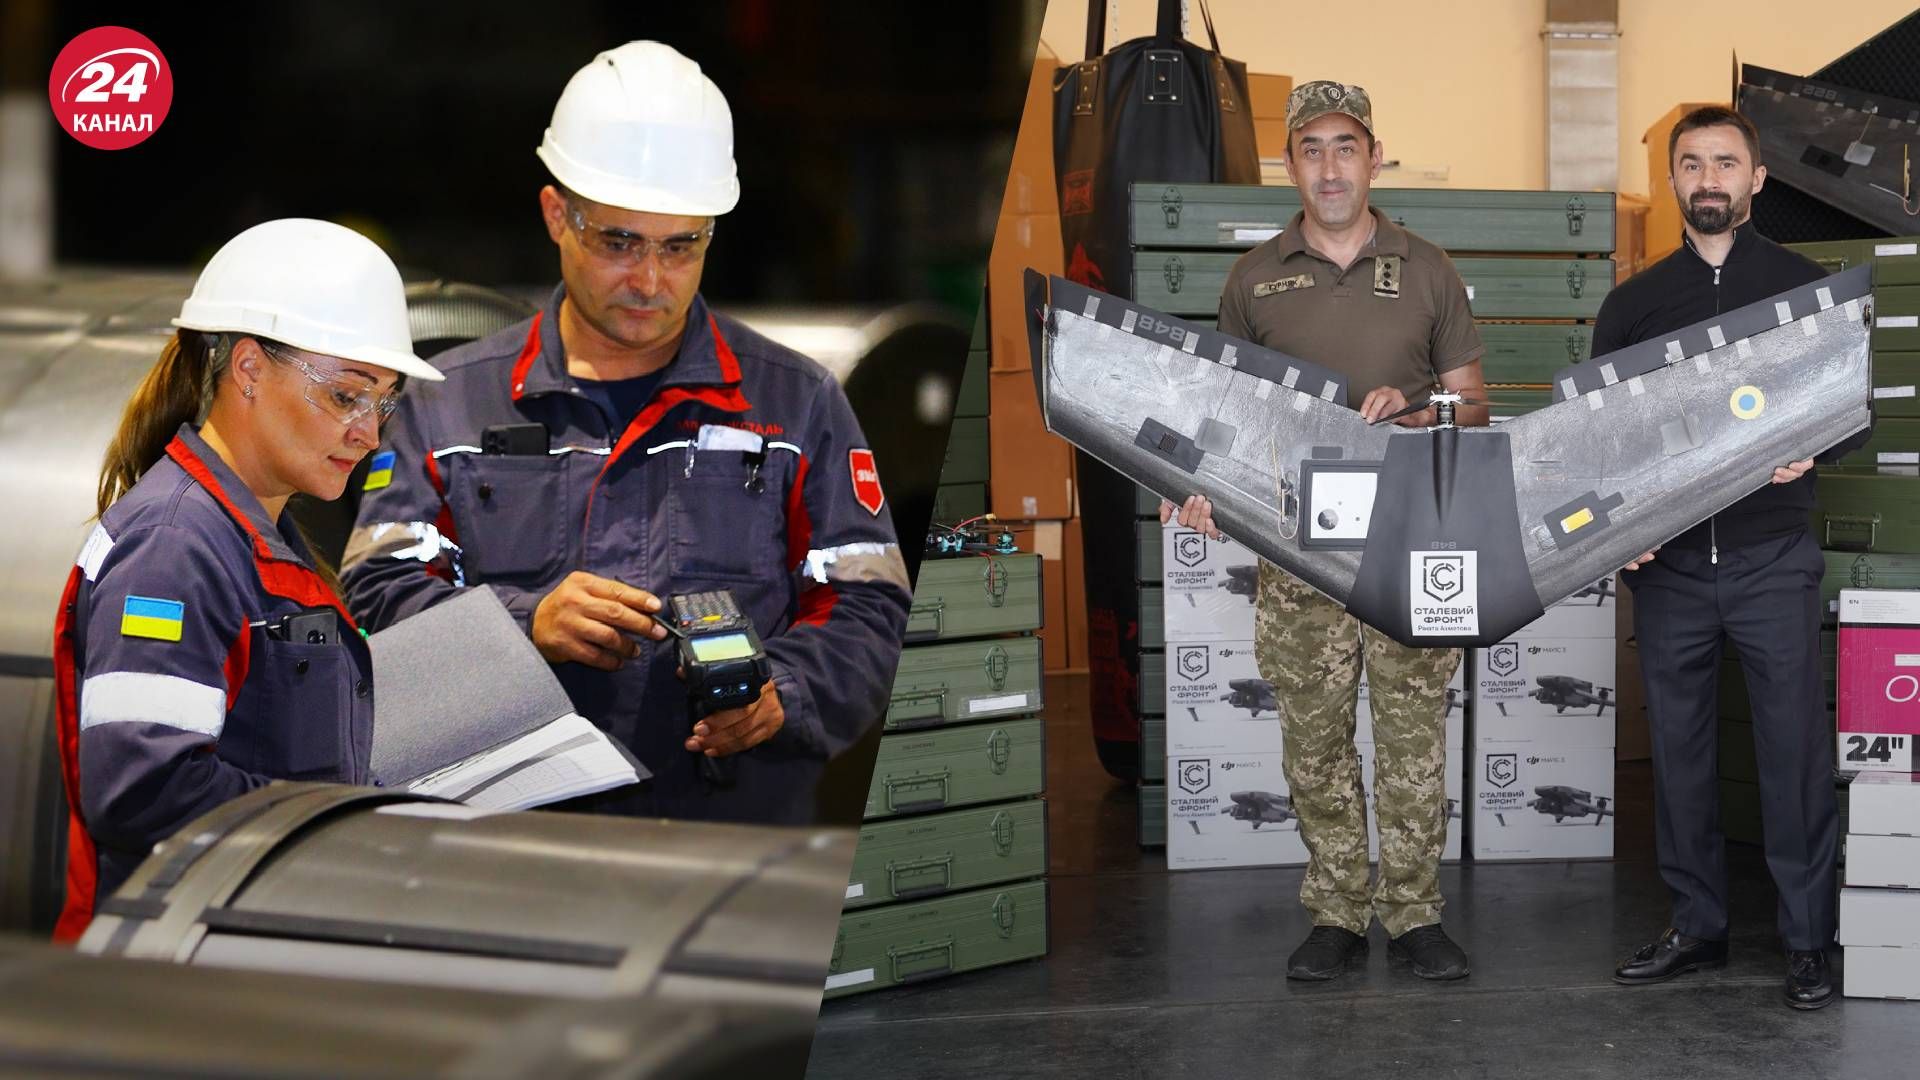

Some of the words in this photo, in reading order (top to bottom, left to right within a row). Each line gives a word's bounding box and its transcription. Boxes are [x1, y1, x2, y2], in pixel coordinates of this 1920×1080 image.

[1139, 315, 1185, 342] 848
[1167, 569, 1215, 577] СТАЛЕВИЙ
[1414, 605, 1474, 615] СТАЛЕВИЙ
[1480, 678, 1526, 687] СТАЛЕВИЙ
[1170, 683, 1218, 692] СТАЛЕВИЙ
[1885, 674, 1920, 703] O
[1846, 735, 1904, 763] 24"
[1479, 790, 1524, 798] СТАЛЕВИЙ
[1170, 796, 1218, 805] СТАЛЕВИЙ
